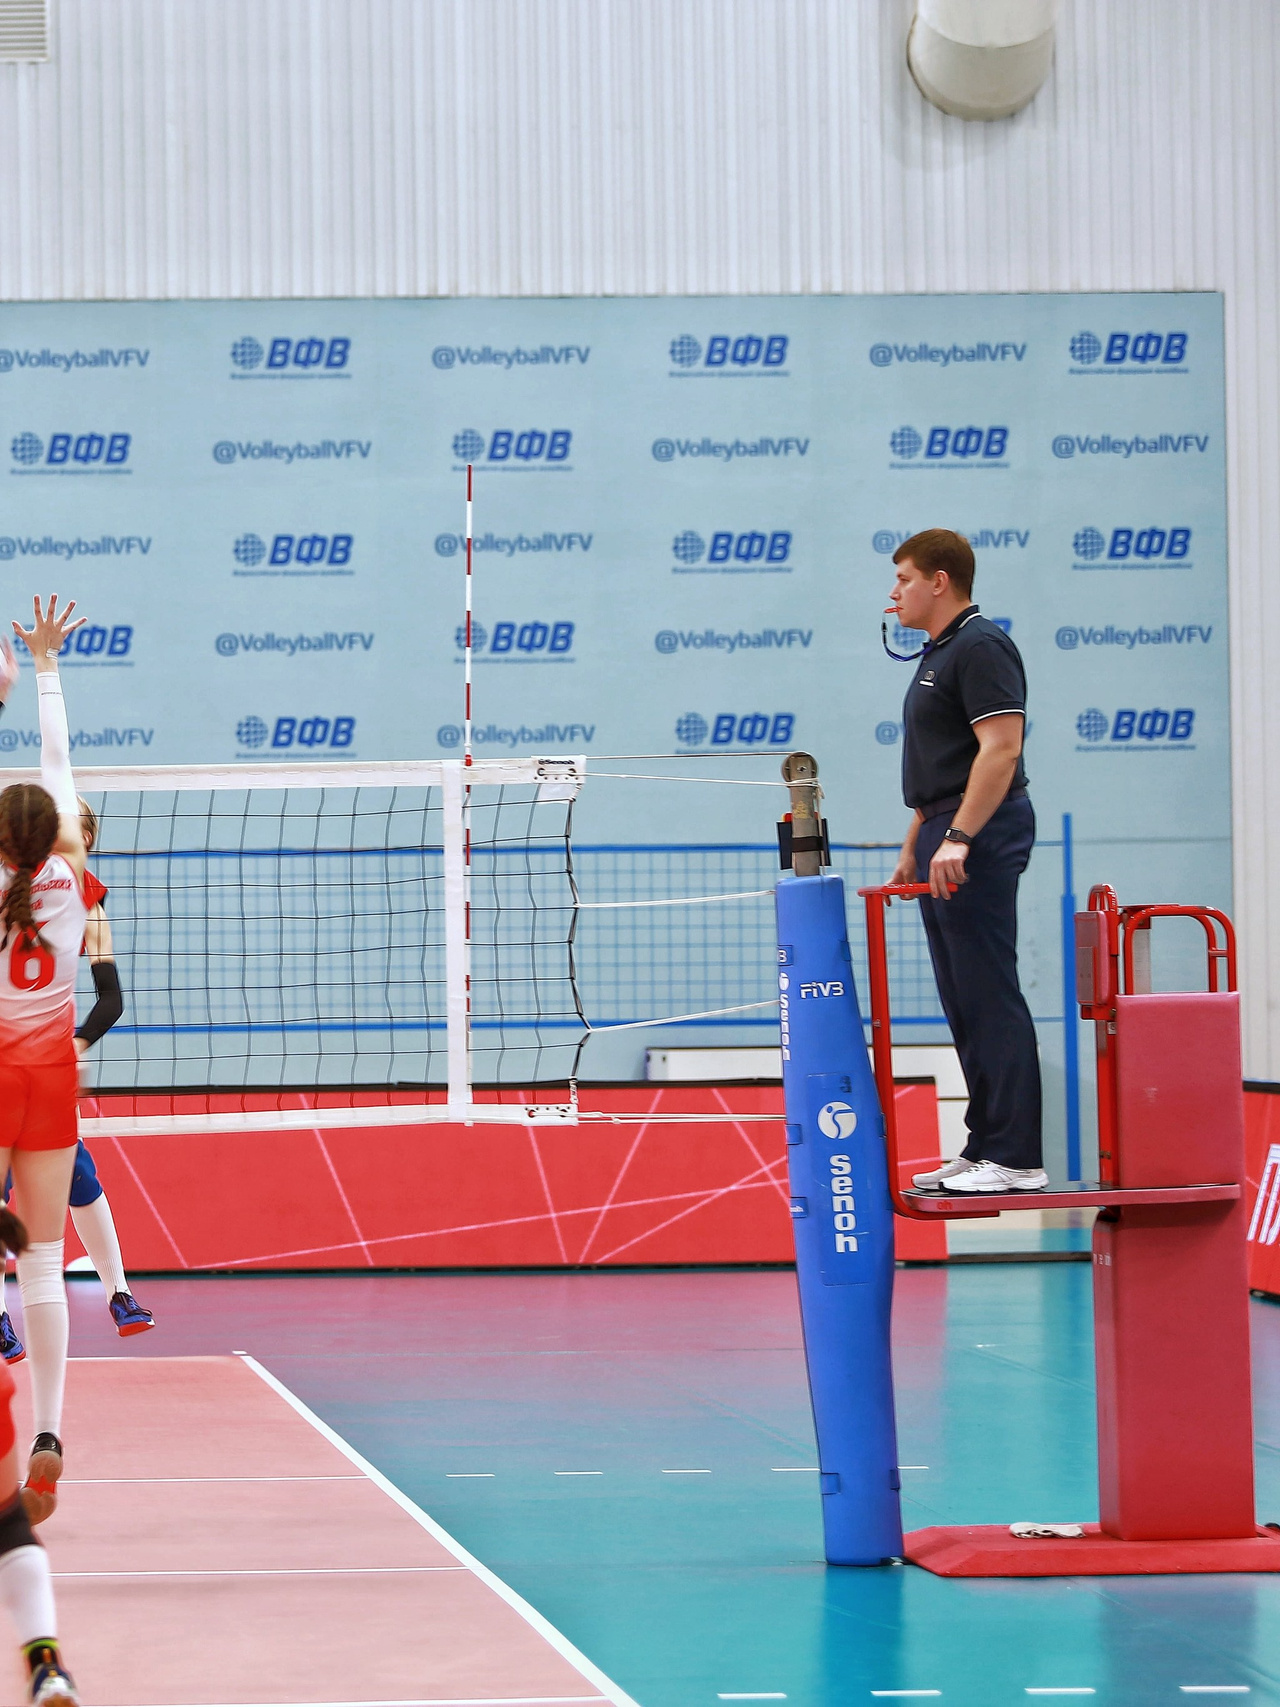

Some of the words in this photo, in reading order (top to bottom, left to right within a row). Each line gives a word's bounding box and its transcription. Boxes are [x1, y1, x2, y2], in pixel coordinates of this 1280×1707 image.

[265, 336, 351, 369] ВФВ
[432, 345, 590, 369] @VolleyballVFV
[704, 334, 789, 367] ВФВ
[869, 343, 1027, 367] @VolleyballVFV
[1104, 331, 1189, 365] ВФВ
[46, 432, 132, 465] ВФВ
[212, 440, 371, 464] @VolleyballVFV
[487, 429, 573, 461] ВФВ
[652, 437, 810, 462] @VolleyballVFV
[925, 425, 1009, 459] ВФВ
[1052, 434, 1209, 459] @VolleyballVFV
[268, 533, 354, 566] ВФВ
[707, 530, 793, 564] ВФВ
[1107, 526, 1192, 560] ВФВ
[215, 632, 374, 656] @VolleyballVFV
[489, 620, 576, 654] ВФВ
[655, 629, 813, 654] @VolleyballVFV
[1055, 625, 1213, 650] @VolleyballVFV
[270, 715, 356, 748] ВФВ
[710, 712, 796, 744] ВФВ
[1110, 708, 1196, 742] ВФВ
[10, 920, 55, 992] 6
